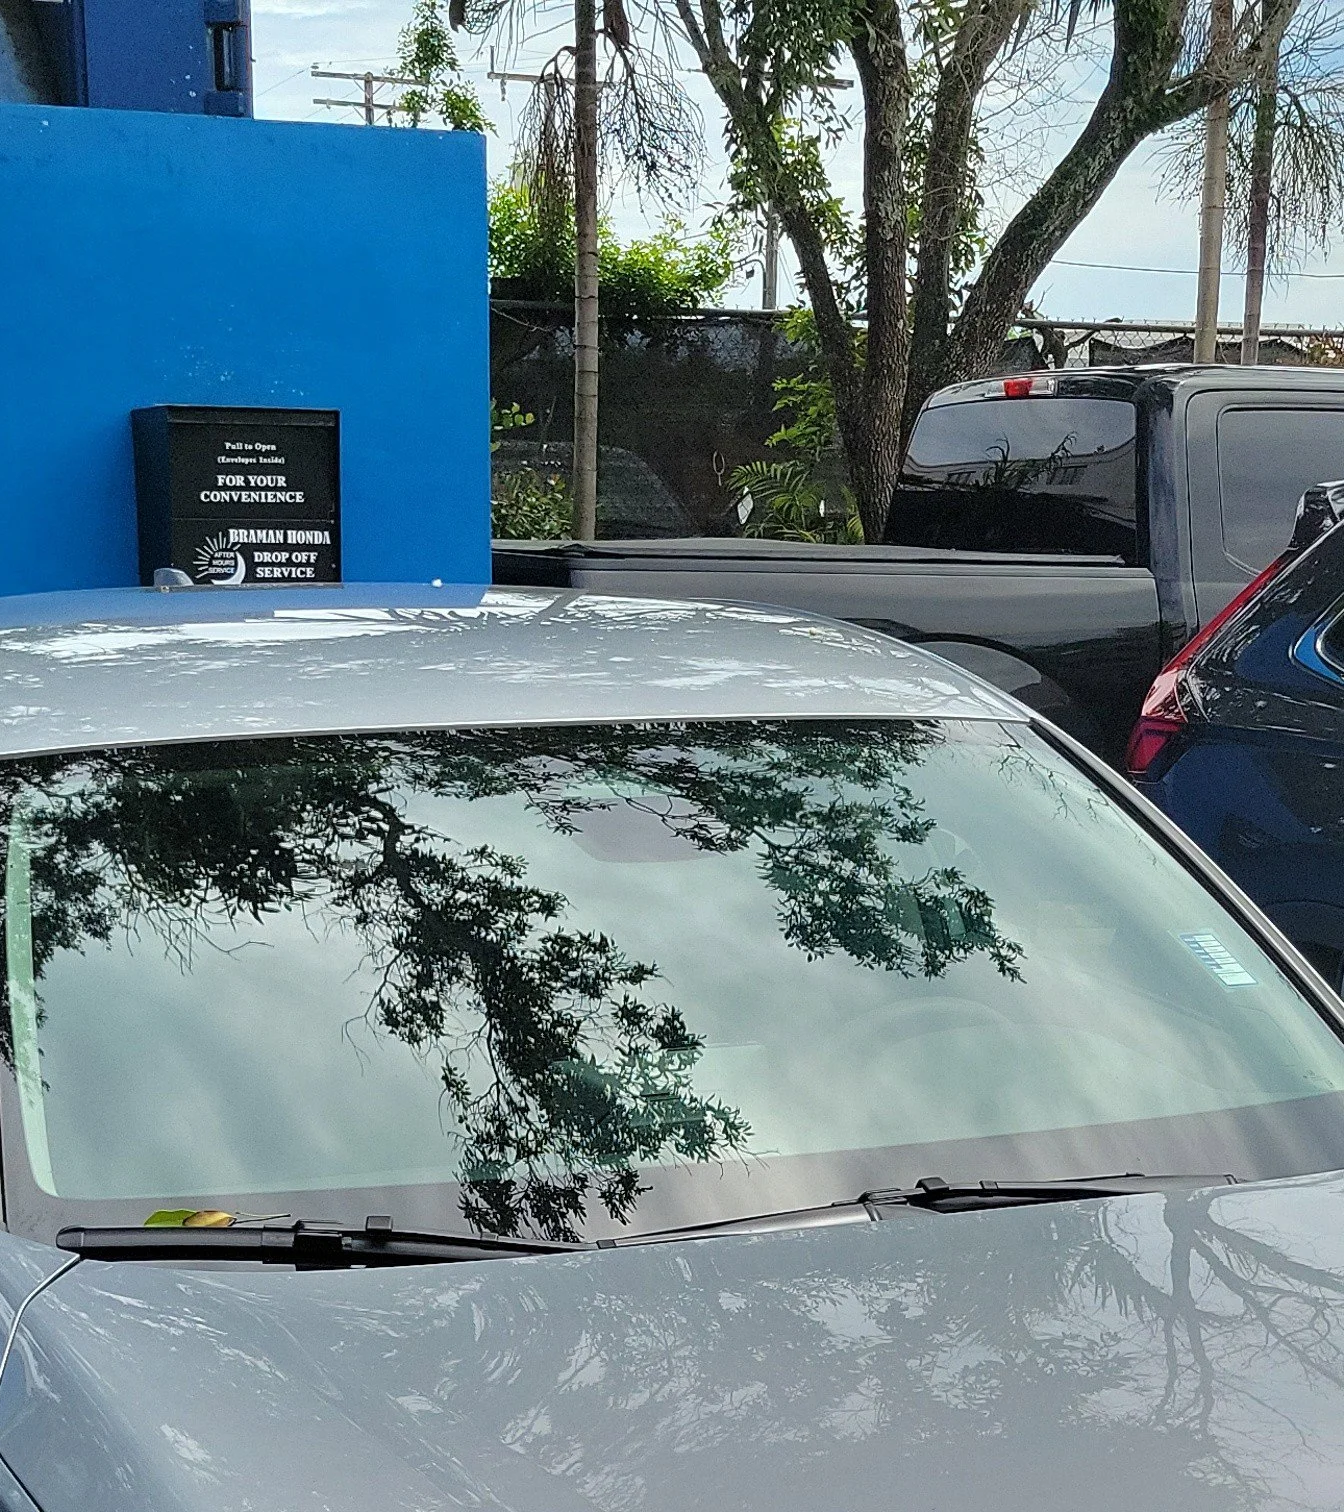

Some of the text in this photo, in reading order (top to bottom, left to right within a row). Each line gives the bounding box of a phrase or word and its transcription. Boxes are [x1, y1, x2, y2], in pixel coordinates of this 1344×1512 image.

[224, 442, 243, 450] Pull
[255, 443, 277, 452] Open
[216, 475, 287, 487] FOR YOUR
[200, 491, 305, 503] CONVENIENCE
[228, 529, 331, 545] BRAMAN HONDA
[253, 552, 318, 563] DROP OFF
[255, 567, 315, 578] SERVICE
